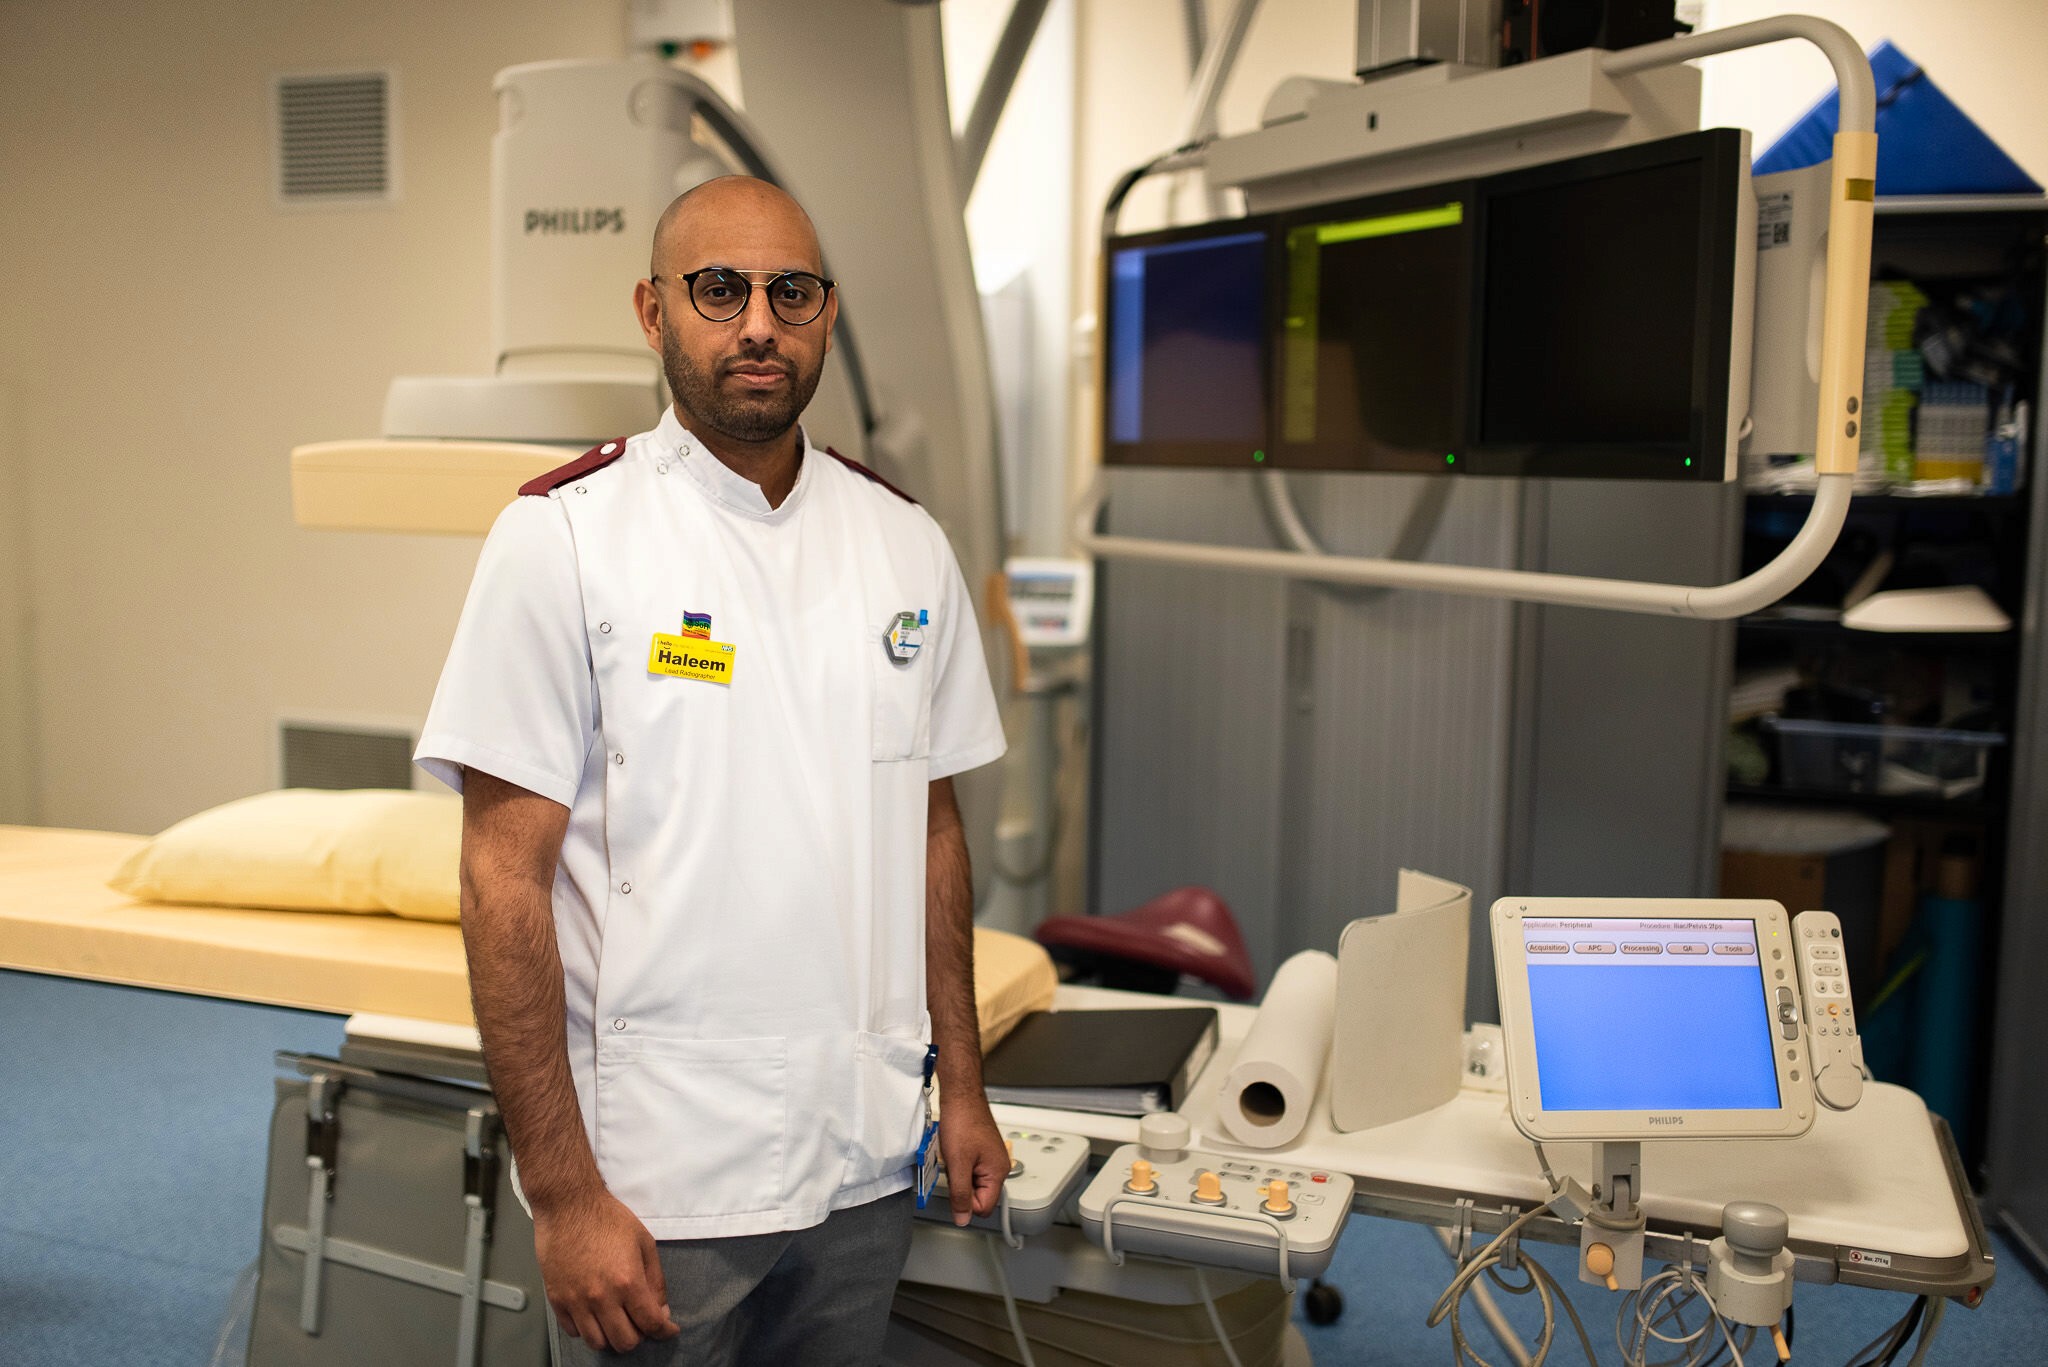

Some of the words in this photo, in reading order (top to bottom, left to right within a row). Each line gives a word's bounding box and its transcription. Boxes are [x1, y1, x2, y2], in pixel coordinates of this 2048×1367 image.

[524, 207, 625, 234] PHILIPS
[658, 650, 725, 672] Haleem
[664, 667, 679, 675] Lead
[680, 669, 716, 680] Radiographer
[1560, 922, 1593, 930] Peripheral
[1529, 944, 1567, 952] Acquisition
[1623, 945, 1660, 953] Processing
[1649, 1116, 1684, 1125] PHILIPS
